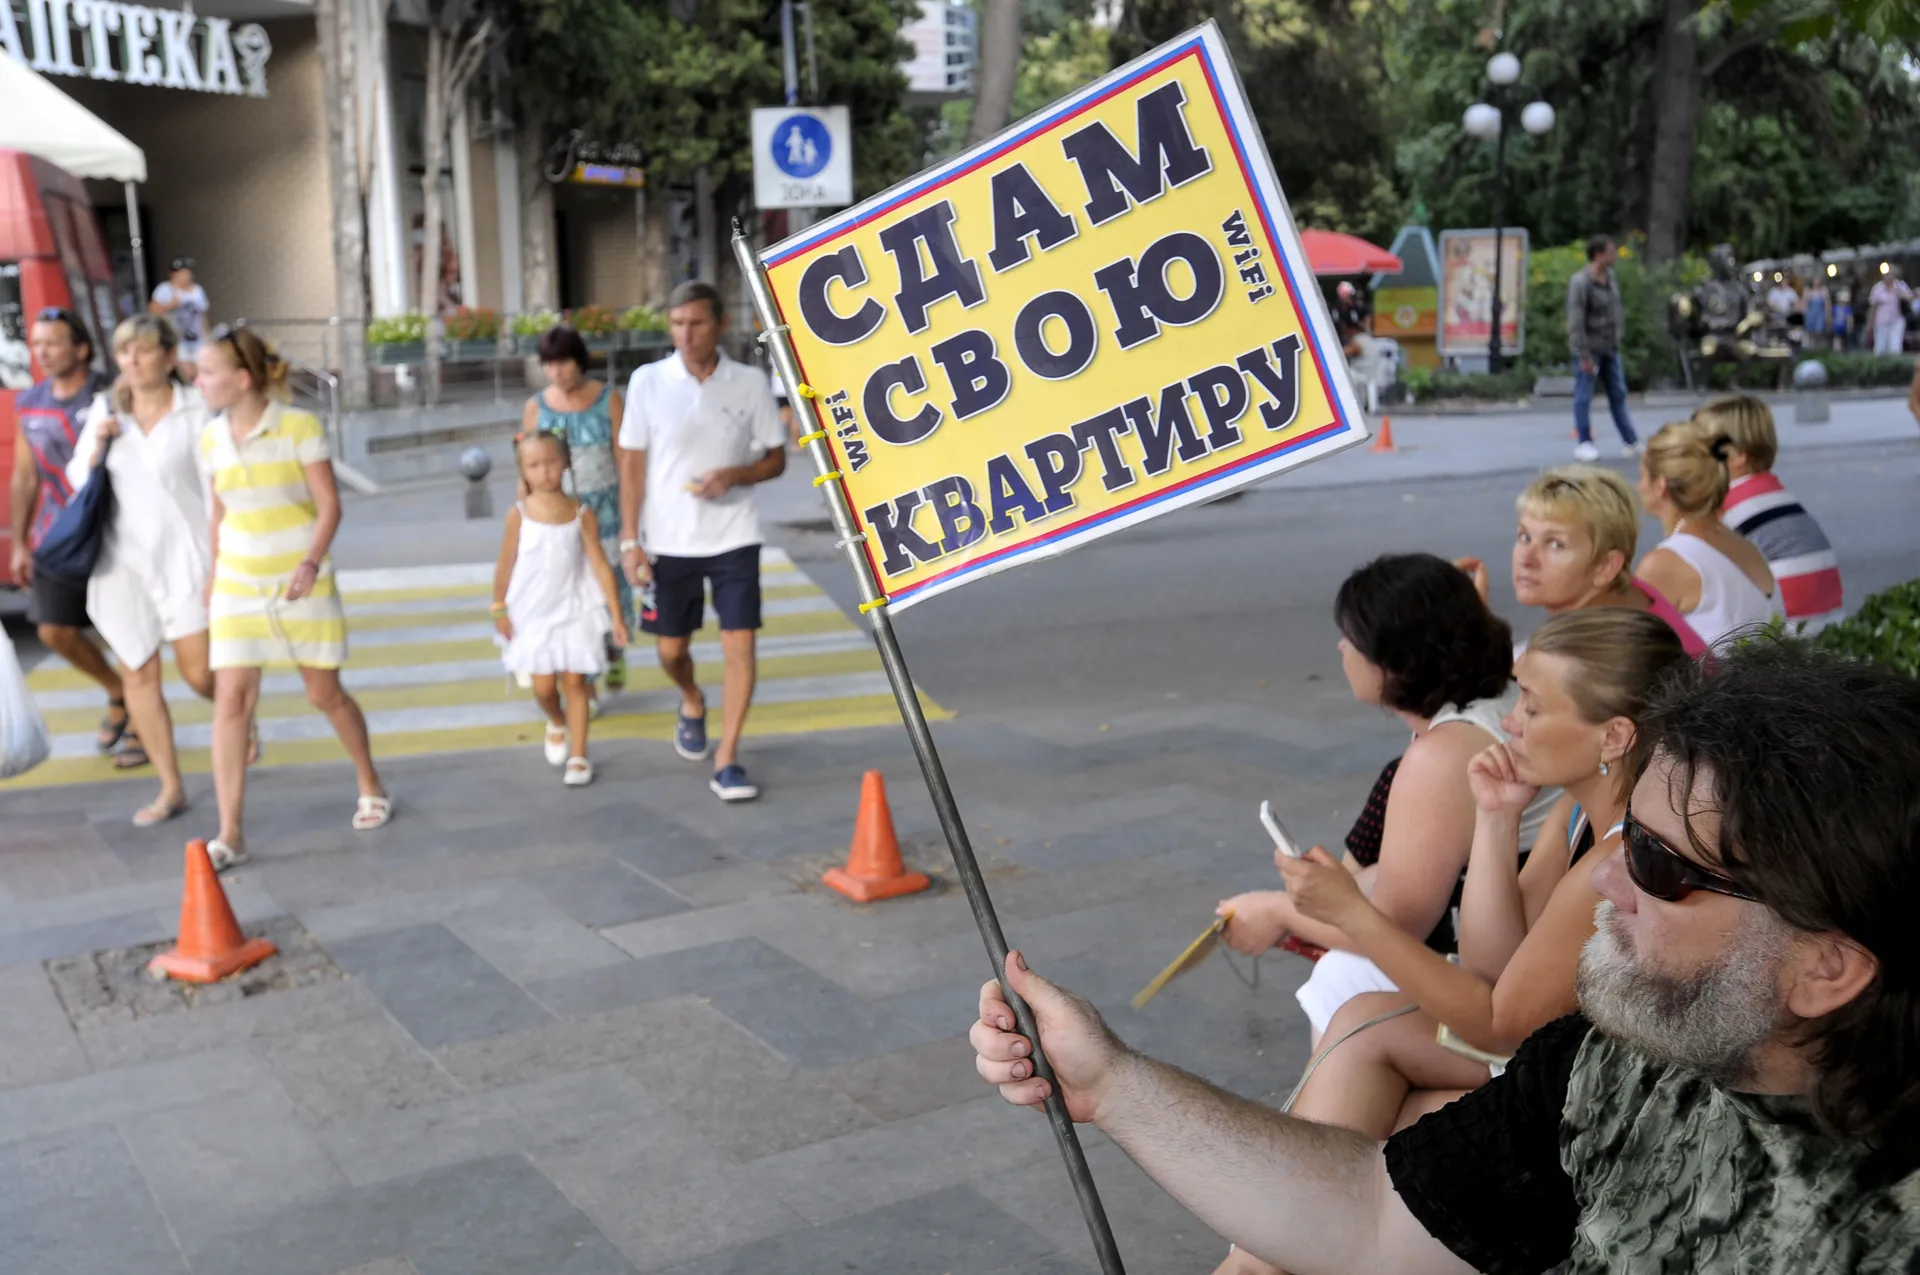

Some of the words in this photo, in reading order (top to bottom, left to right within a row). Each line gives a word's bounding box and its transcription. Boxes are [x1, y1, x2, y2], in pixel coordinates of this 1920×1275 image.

[798, 79, 1214, 346] СДАМ
[861, 231, 1225, 446] СВОЮ
[865, 332, 1304, 578] КВАРТИРУ
